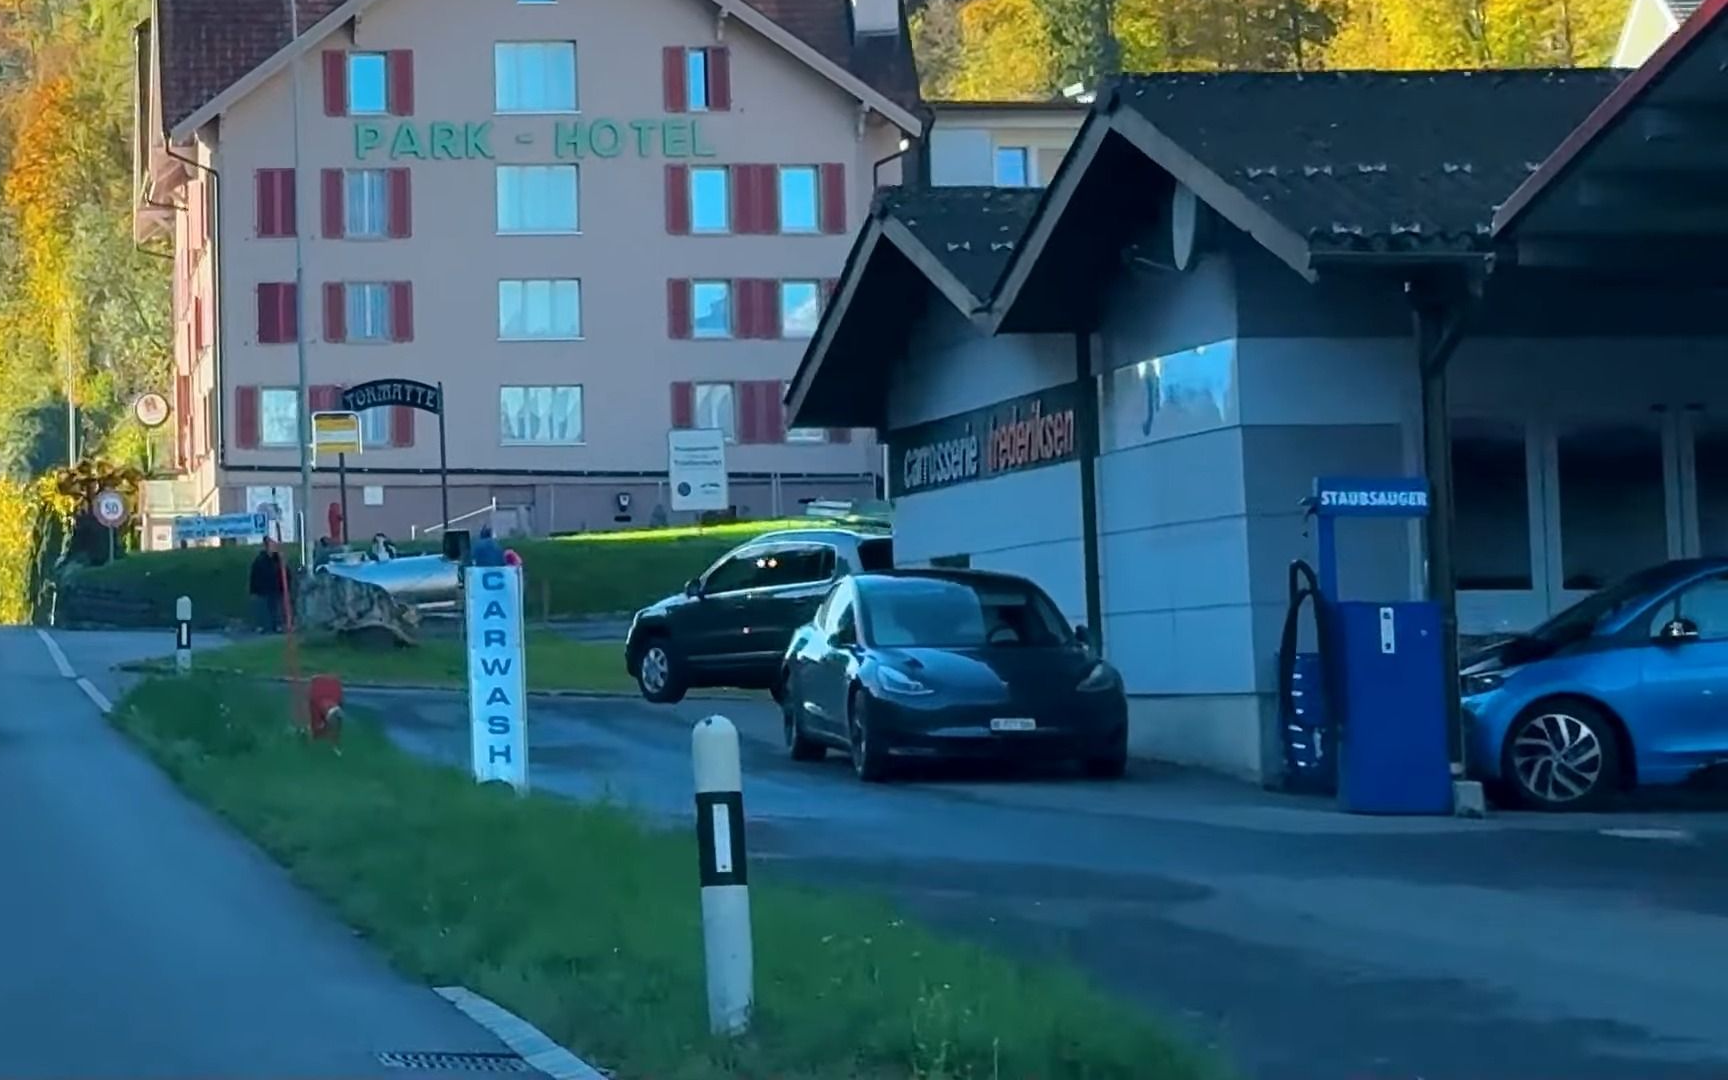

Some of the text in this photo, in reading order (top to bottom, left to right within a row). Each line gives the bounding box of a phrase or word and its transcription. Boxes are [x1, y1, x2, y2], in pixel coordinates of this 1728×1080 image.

[354, 120, 495, 160] PARK
[554, 118, 716, 158] HOTEL
[104, 502, 119, 515] 50
[1320, 490, 1428, 507] STAUBSAUGER
[480, 571, 512, 764] CARWASH
